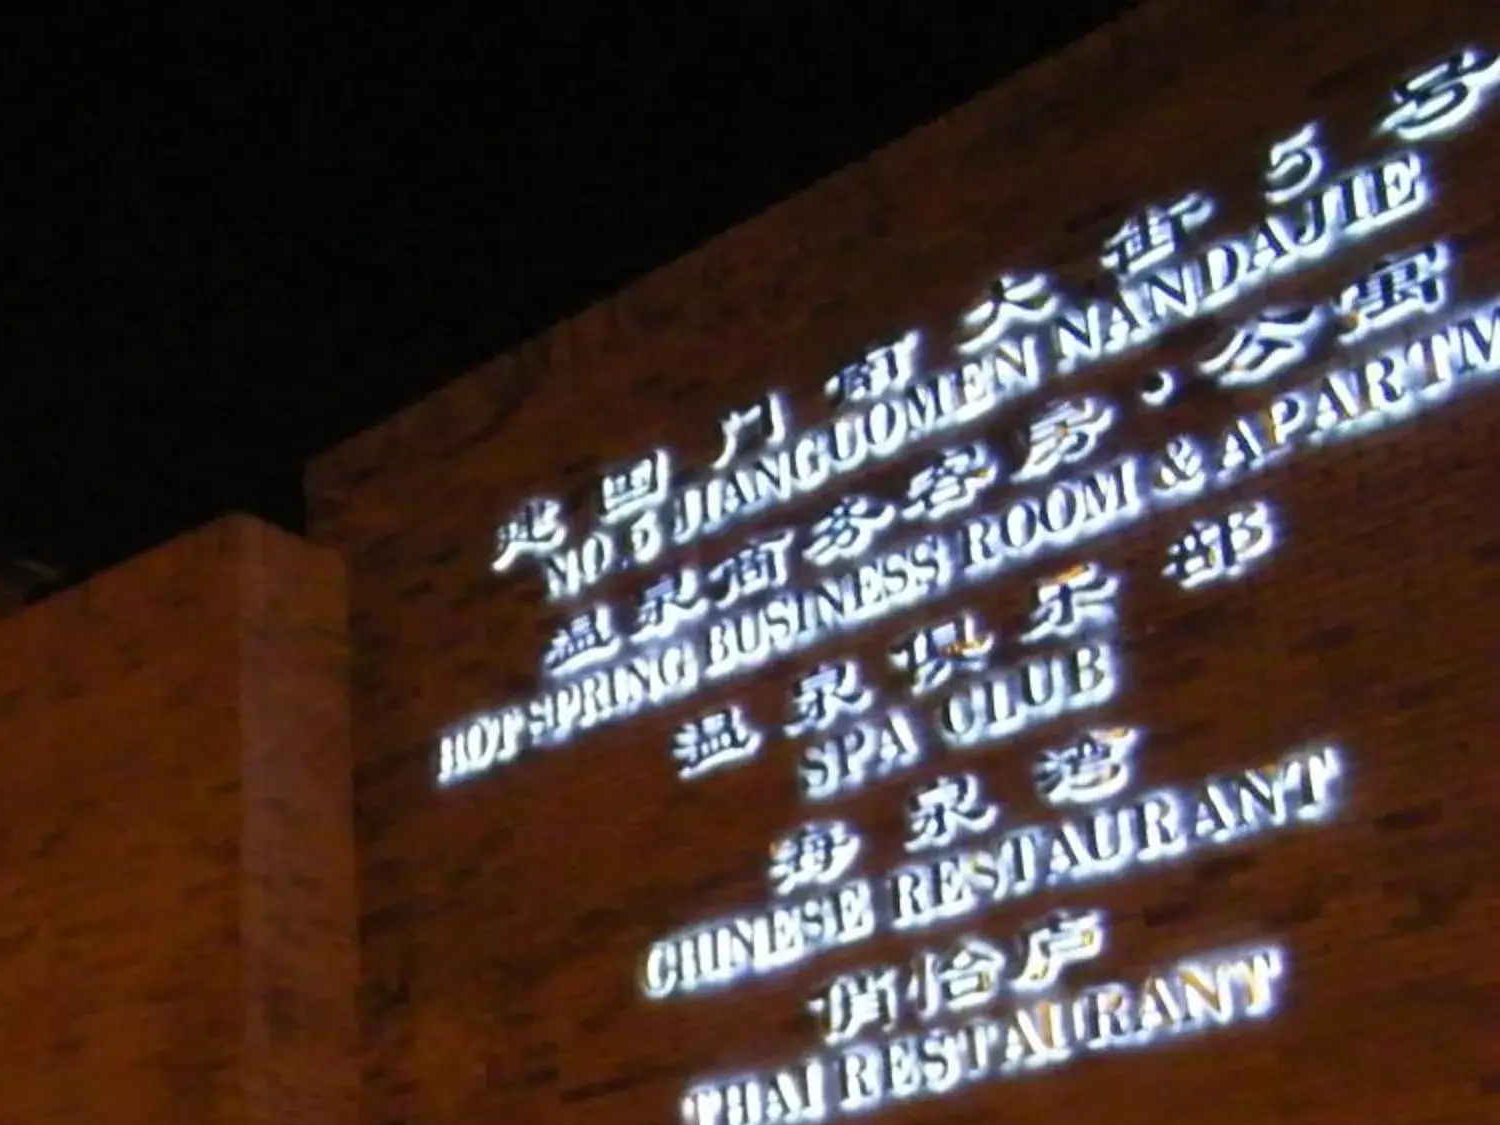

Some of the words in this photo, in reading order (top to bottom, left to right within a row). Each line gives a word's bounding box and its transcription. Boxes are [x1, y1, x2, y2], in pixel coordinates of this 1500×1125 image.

[672, 335, 1041, 544] JIANGUOMEN
[1050, 153, 1429, 374] NANDAJIE
[438, 707, 527, 784] HOT
[527, 643, 699, 745] SPRING
[704, 535, 951, 680] BUSINESS
[963, 457, 1141, 573] ROOM
[1150, 436, 1206, 500] &
[801, 709, 920, 799] SPA
[940, 640, 1117, 746] CLUB
[644, 878, 876, 998] CHINESE
[892, 747, 1341, 930] RESTAURANT
[839, 946, 1283, 1113] RESTAURANT
